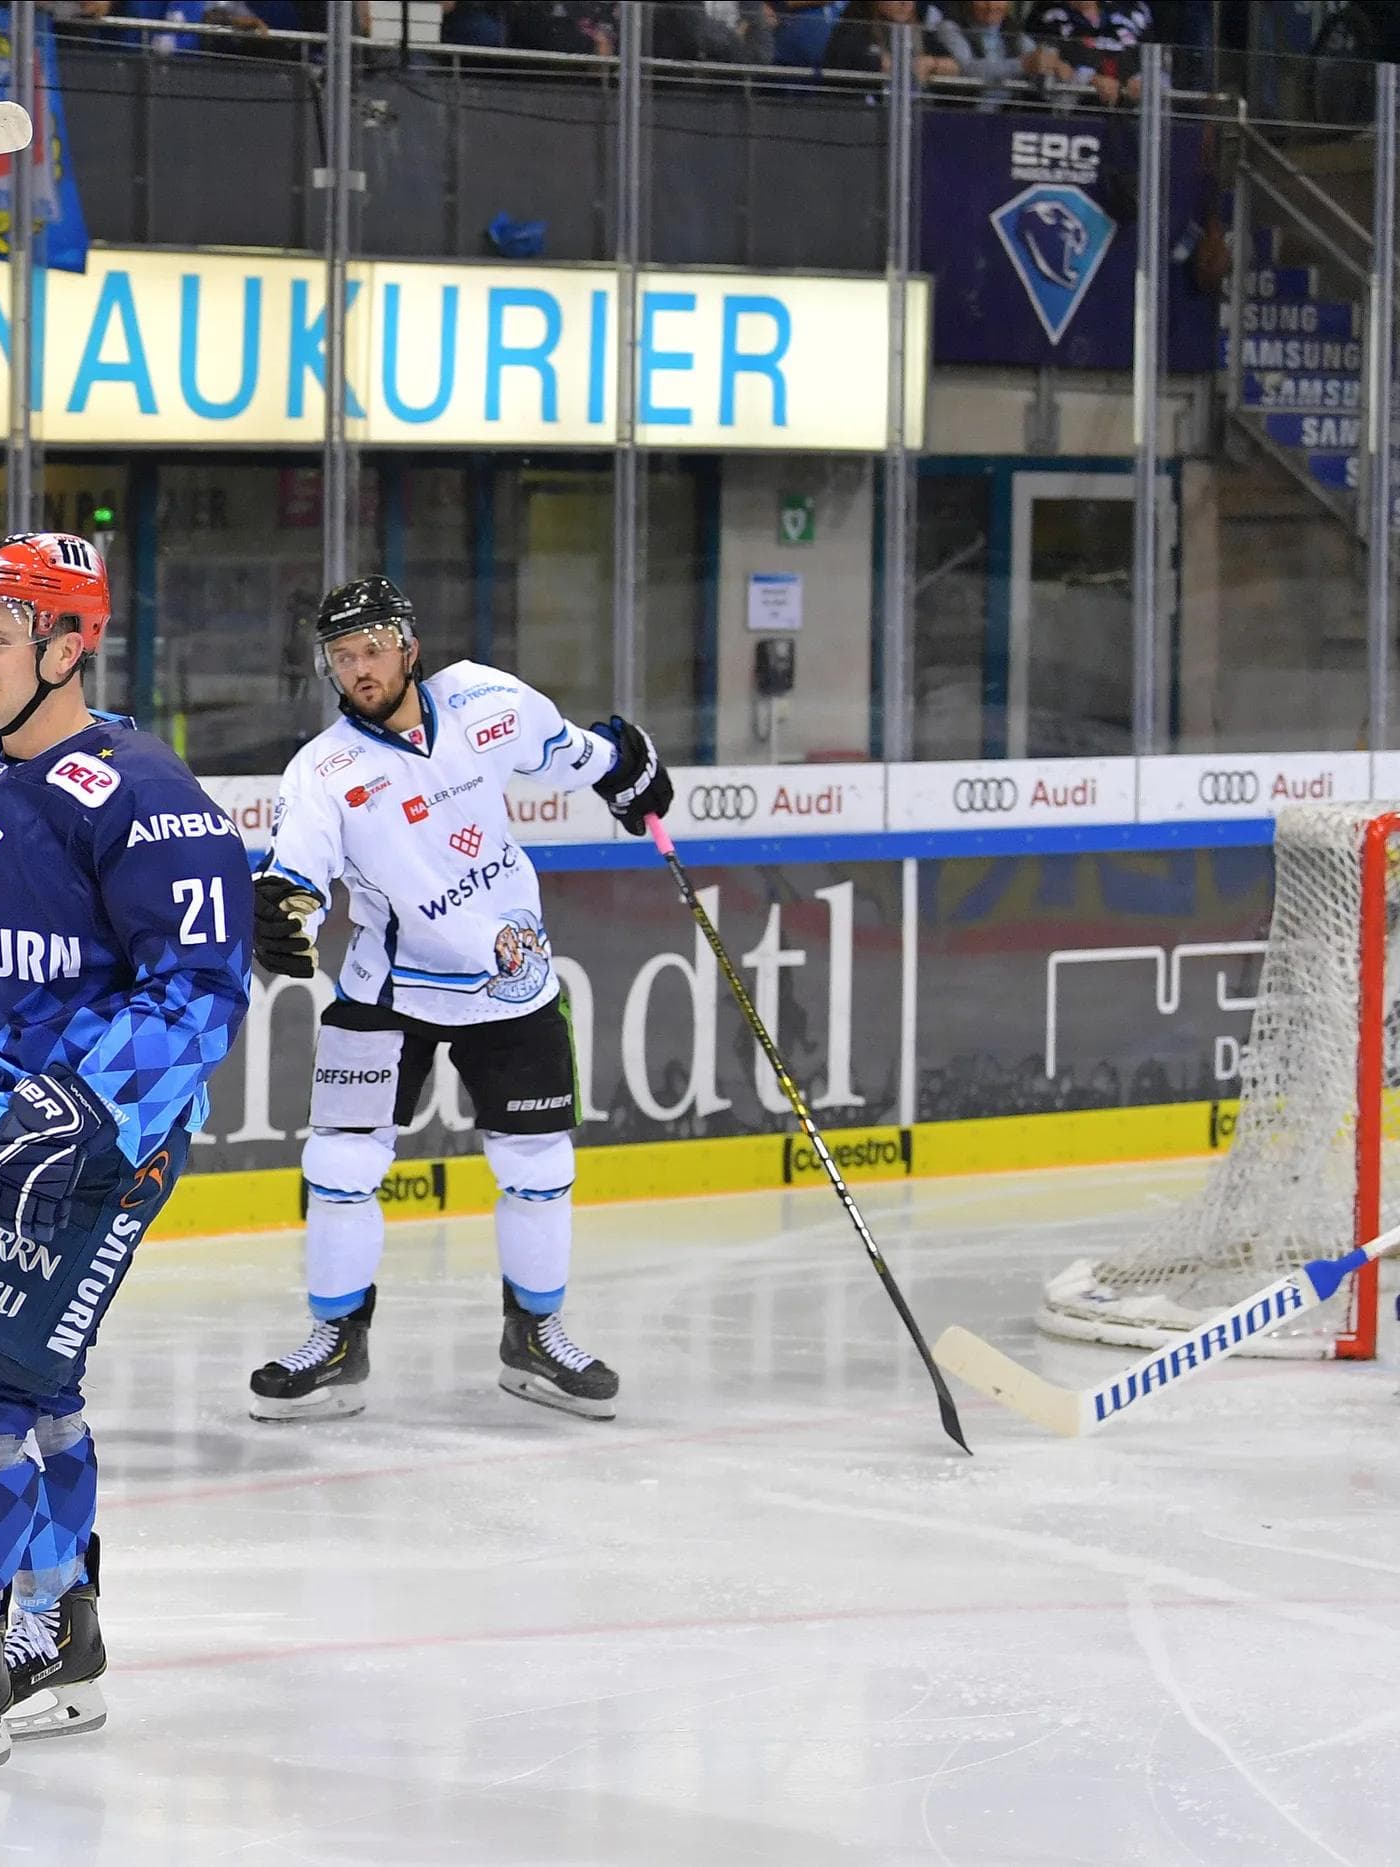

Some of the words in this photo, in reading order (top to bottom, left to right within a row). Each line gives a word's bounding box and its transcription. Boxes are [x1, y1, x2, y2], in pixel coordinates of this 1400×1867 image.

[1011, 131, 1101, 170] ERC
[771, 786, 843, 815] Audi
[1030, 779, 1097, 807] Audi
[1271, 772, 1333, 800] Audi
[172, 876, 227, 945] 21
[315, 1068, 392, 1085] DEFSHOP
[506, 1093, 573, 1113] BAUER
[45, 1212, 143, 1359] SATURN
[1094, 1286, 1303, 1423] WARRIOR
